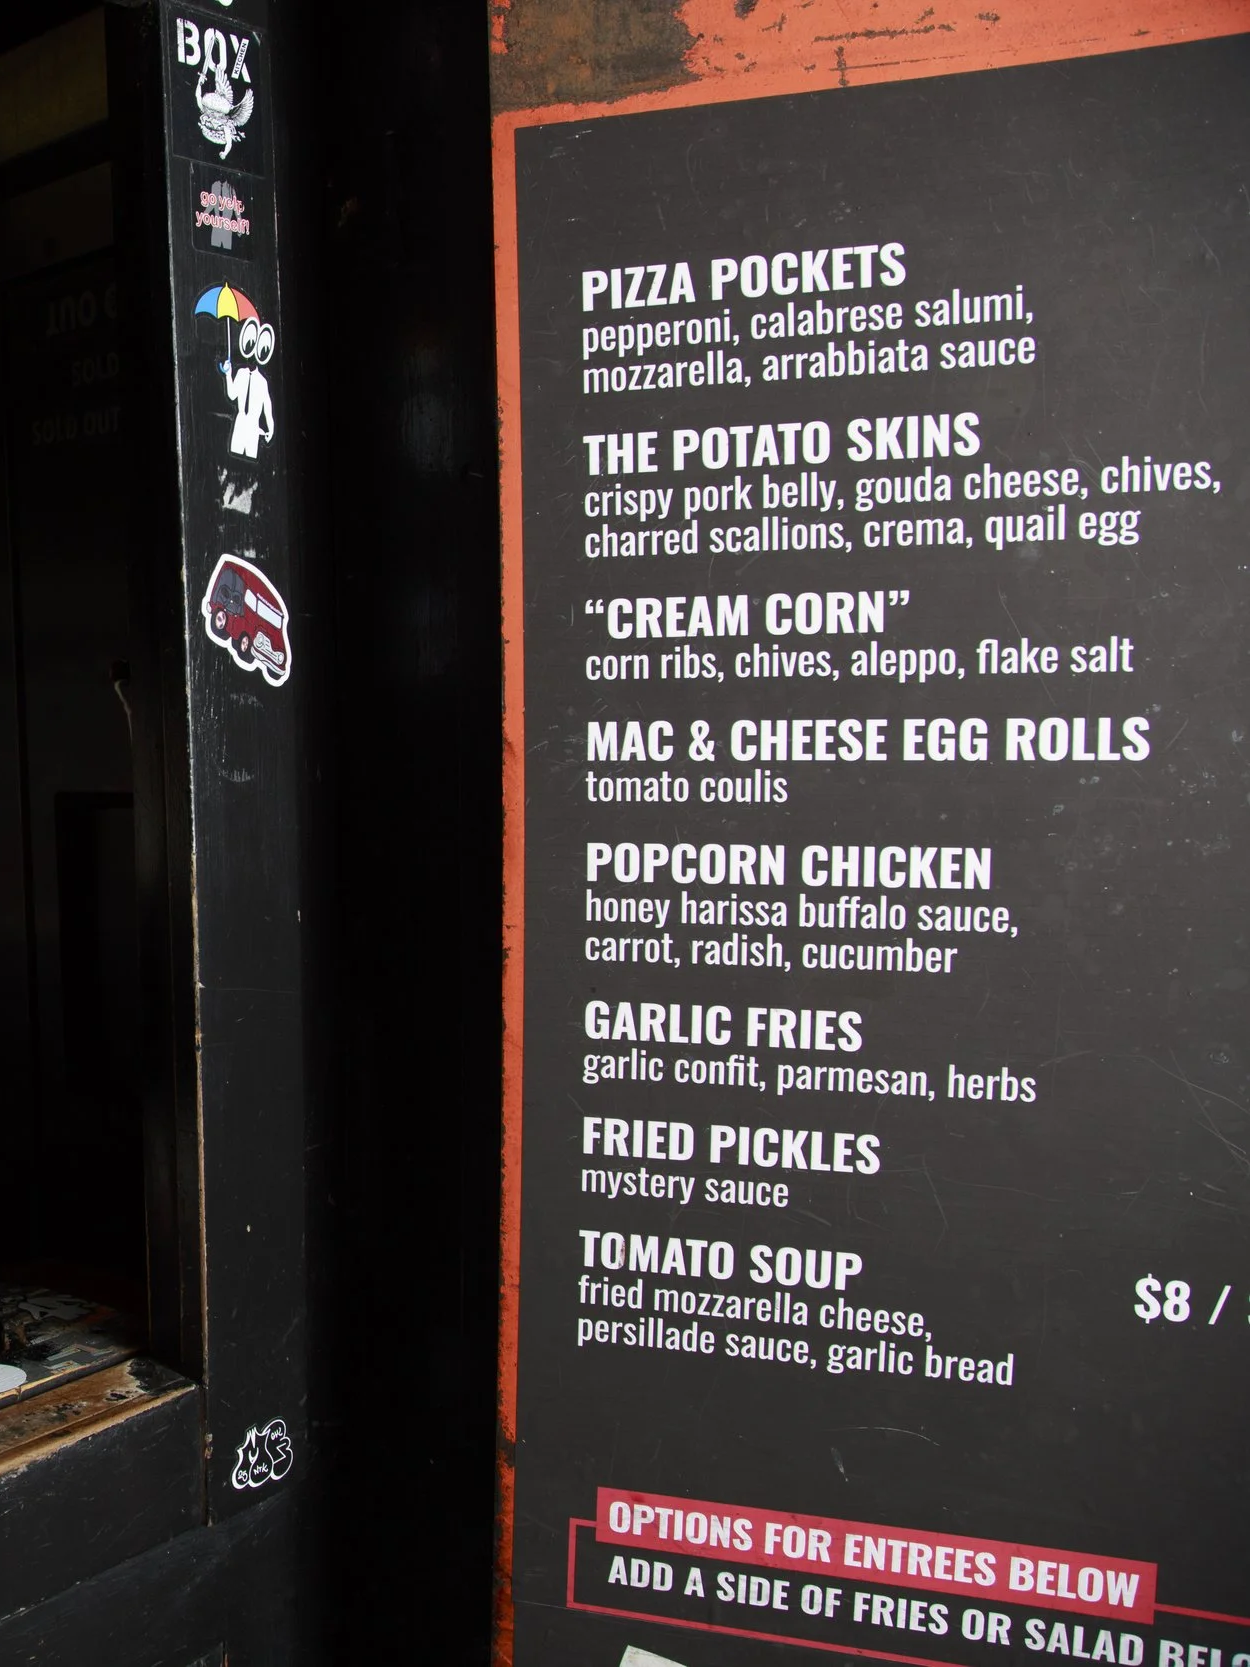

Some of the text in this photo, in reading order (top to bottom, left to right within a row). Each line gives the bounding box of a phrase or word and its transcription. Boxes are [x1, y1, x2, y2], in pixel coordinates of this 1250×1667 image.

[176, 17, 252, 84] BOX
[233, 42, 247, 75] KITCHEN
[200, 191, 217, 207] go
[582, 242, 907, 312] PIZZA POCKETS
[582, 284, 1033, 361] pepperoni, calabrese salumi,
[583, 336, 1036, 394] mozzarella, arrabbiata sauce
[582, 411, 981, 476] THE POTATO SKINS
[584, 455, 1221, 522] crispy pork belly, gouda cheese, chives,
[584, 503, 1142, 559] charred scallions, crema, quail egg
[585, 635, 1135, 684] corn ribs, chives, aleppo, flake salt
[587, 716, 1151, 762] MAC & CHEESE EGG ROLLS
[585, 768, 788, 803] tomato coulis
[586, 842, 992, 890] POPCORN CHICKEN
[586, 888, 1018, 938] honey harissa buffalo sauce,
[585, 932, 958, 973] carrot, radish, cucumber
[584, 1000, 863, 1053] GARLIC FRIES
[582, 1047, 1037, 1103] garlic confit, parmesan, herbs
[583, 1116, 881, 1175] FRIED PICKLES
[581, 1167, 789, 1208] mystery sauce
[578, 1229, 863, 1291] TOMATO SOUP
[578, 1274, 932, 1343] fried mozzarella cheese,
[1134, 1273, 1191, 1324] $8
[1208, 1285, 1232, 1325] /
[577, 1317, 1014, 1386] persillade sauce, garlic bread
[608, 1501, 1140, 1608] OPTIONS FOR ENTREES BELOW
[607, 1555, 673, 1591] ADD
[683, 1567, 705, 1598] A
[716, 1571, 790, 1611] SIDE
[800, 1584, 842, 1618] OF
[853, 1591, 949, 1635] FRIES
[961, 1608, 1012, 1646] OR
[1024, 1618, 1144, 1666] SALAD
